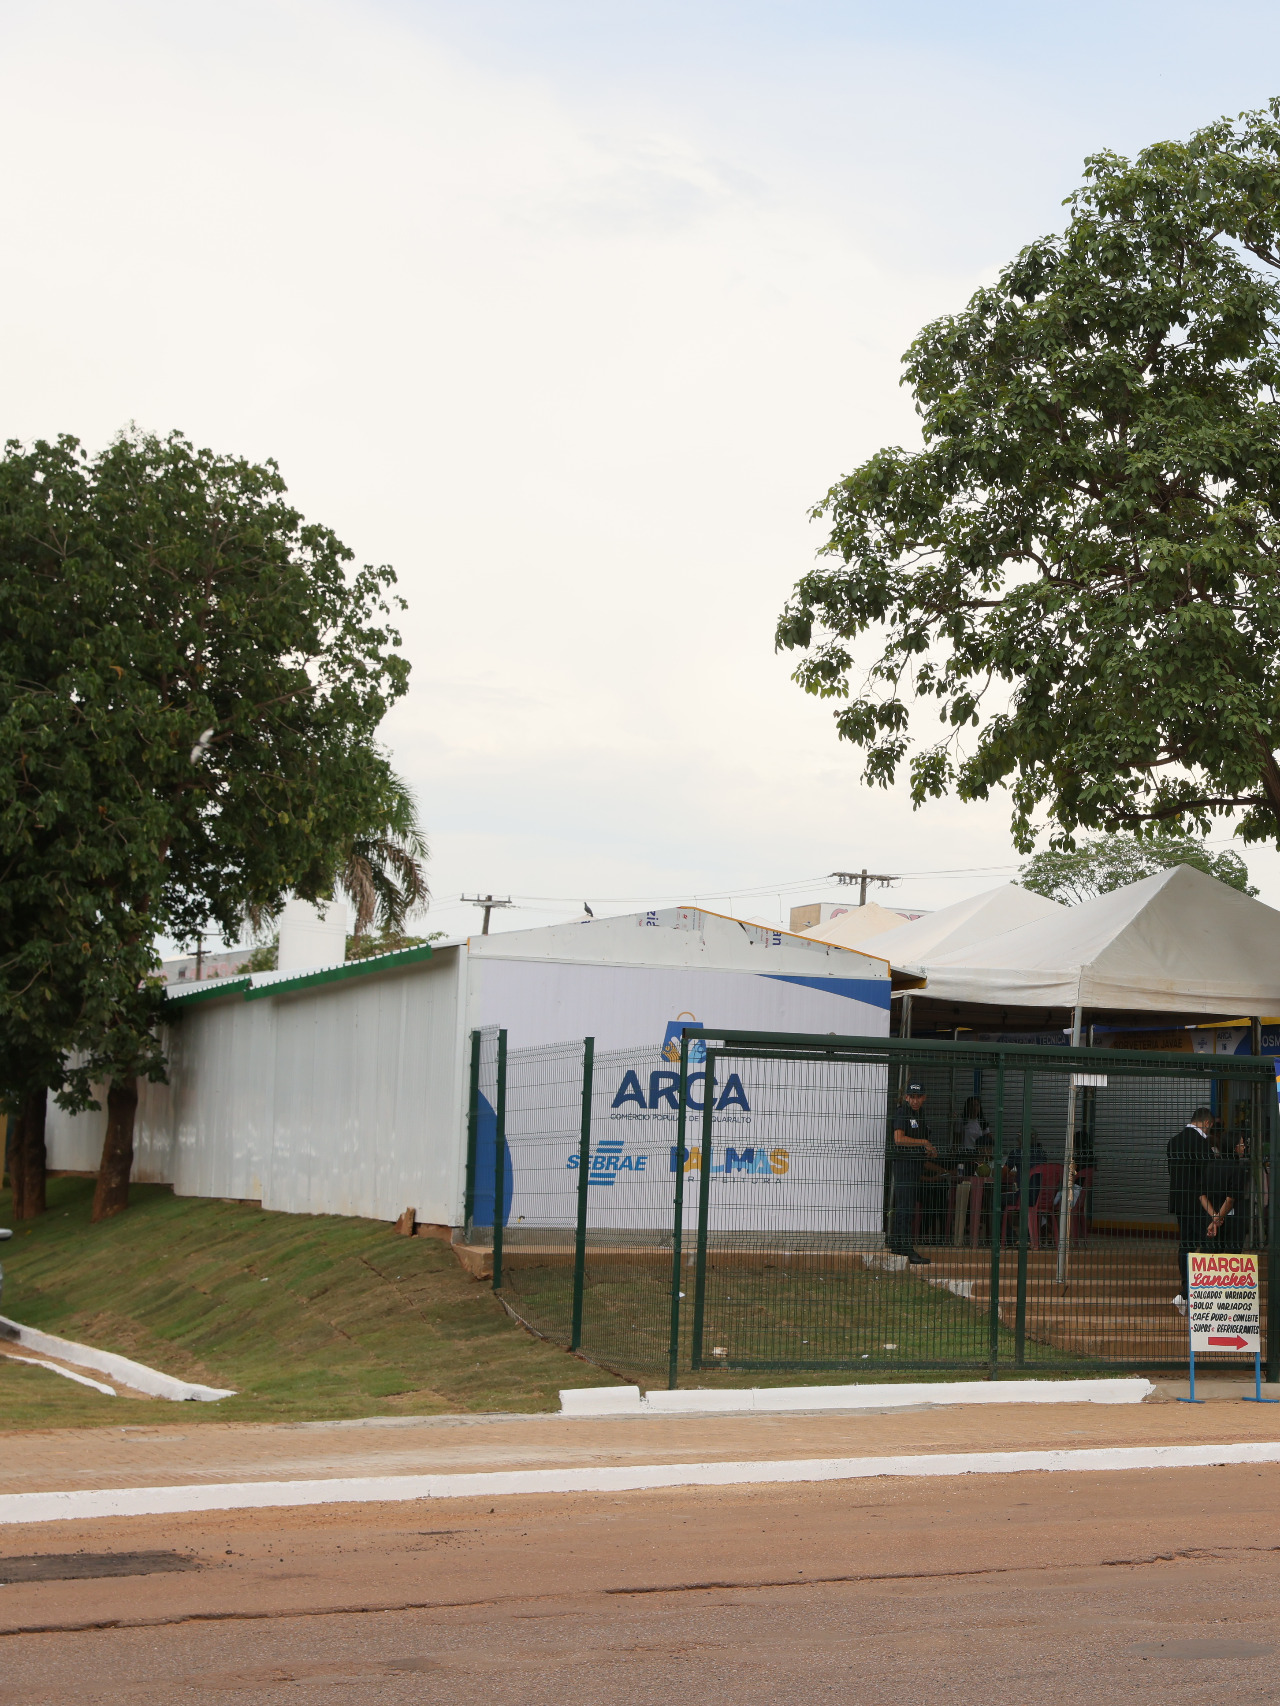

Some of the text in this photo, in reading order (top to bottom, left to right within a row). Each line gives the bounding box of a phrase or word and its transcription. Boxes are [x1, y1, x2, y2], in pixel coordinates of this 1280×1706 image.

[611, 1070, 751, 1111] ARCA
[670, 1146, 790, 1174] PALMAS
[1191, 1255, 1256, 1272] MÁRCIA
[1190, 1273, 1256, 1286] Lanches
[1225, 1291, 1257, 1300] VARIADOS
[1193, 1302, 1253, 1311] BOLOS VARIADOS
[1210, 1313, 1228, 1322] PURO
[1216, 1325, 1259, 1334] REFRIGERANTES
